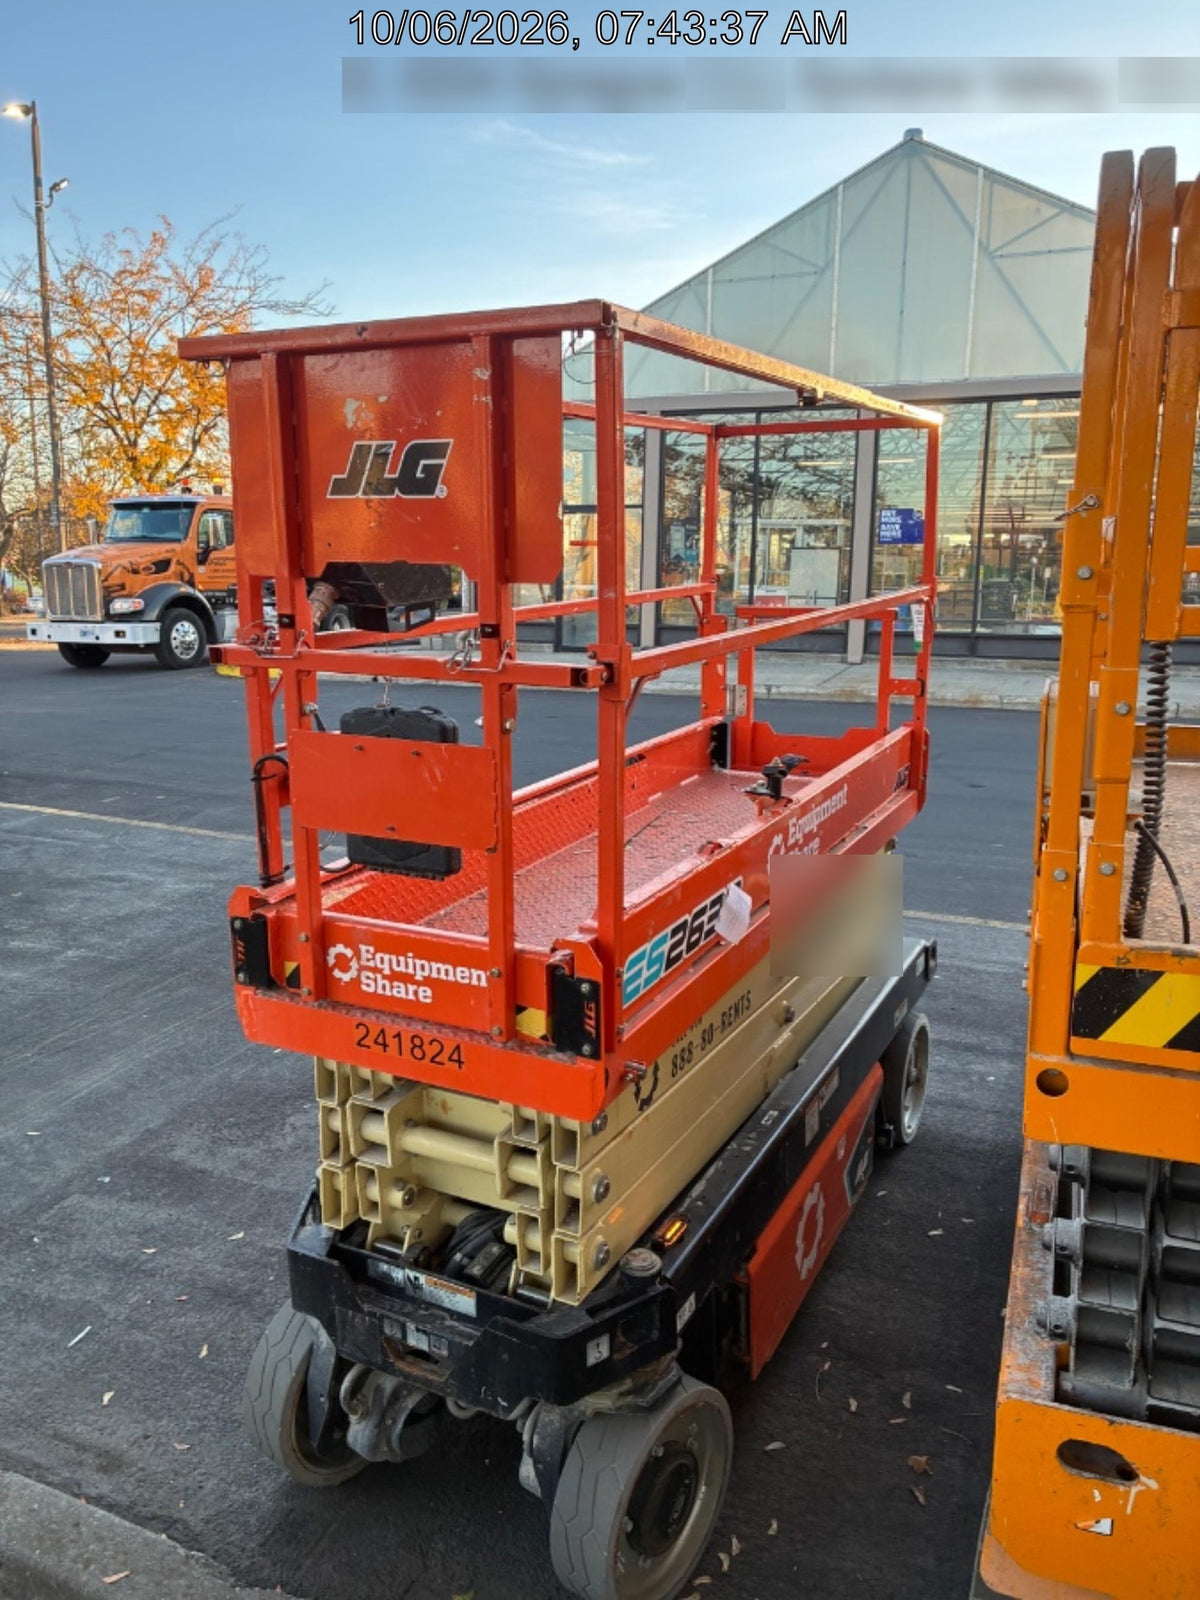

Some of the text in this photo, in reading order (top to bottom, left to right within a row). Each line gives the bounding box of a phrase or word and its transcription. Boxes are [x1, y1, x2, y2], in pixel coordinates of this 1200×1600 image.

[326, 439, 453, 498] JLG
[787, 783, 848, 847] Equipment
[359, 944, 489, 987] Equipmen
[622, 877, 743, 1009] ES263
[360, 970, 433, 1003] Share
[355, 1022, 465, 1070] 241824
[671, 989, 751, 1078] 888-80-RENTS
